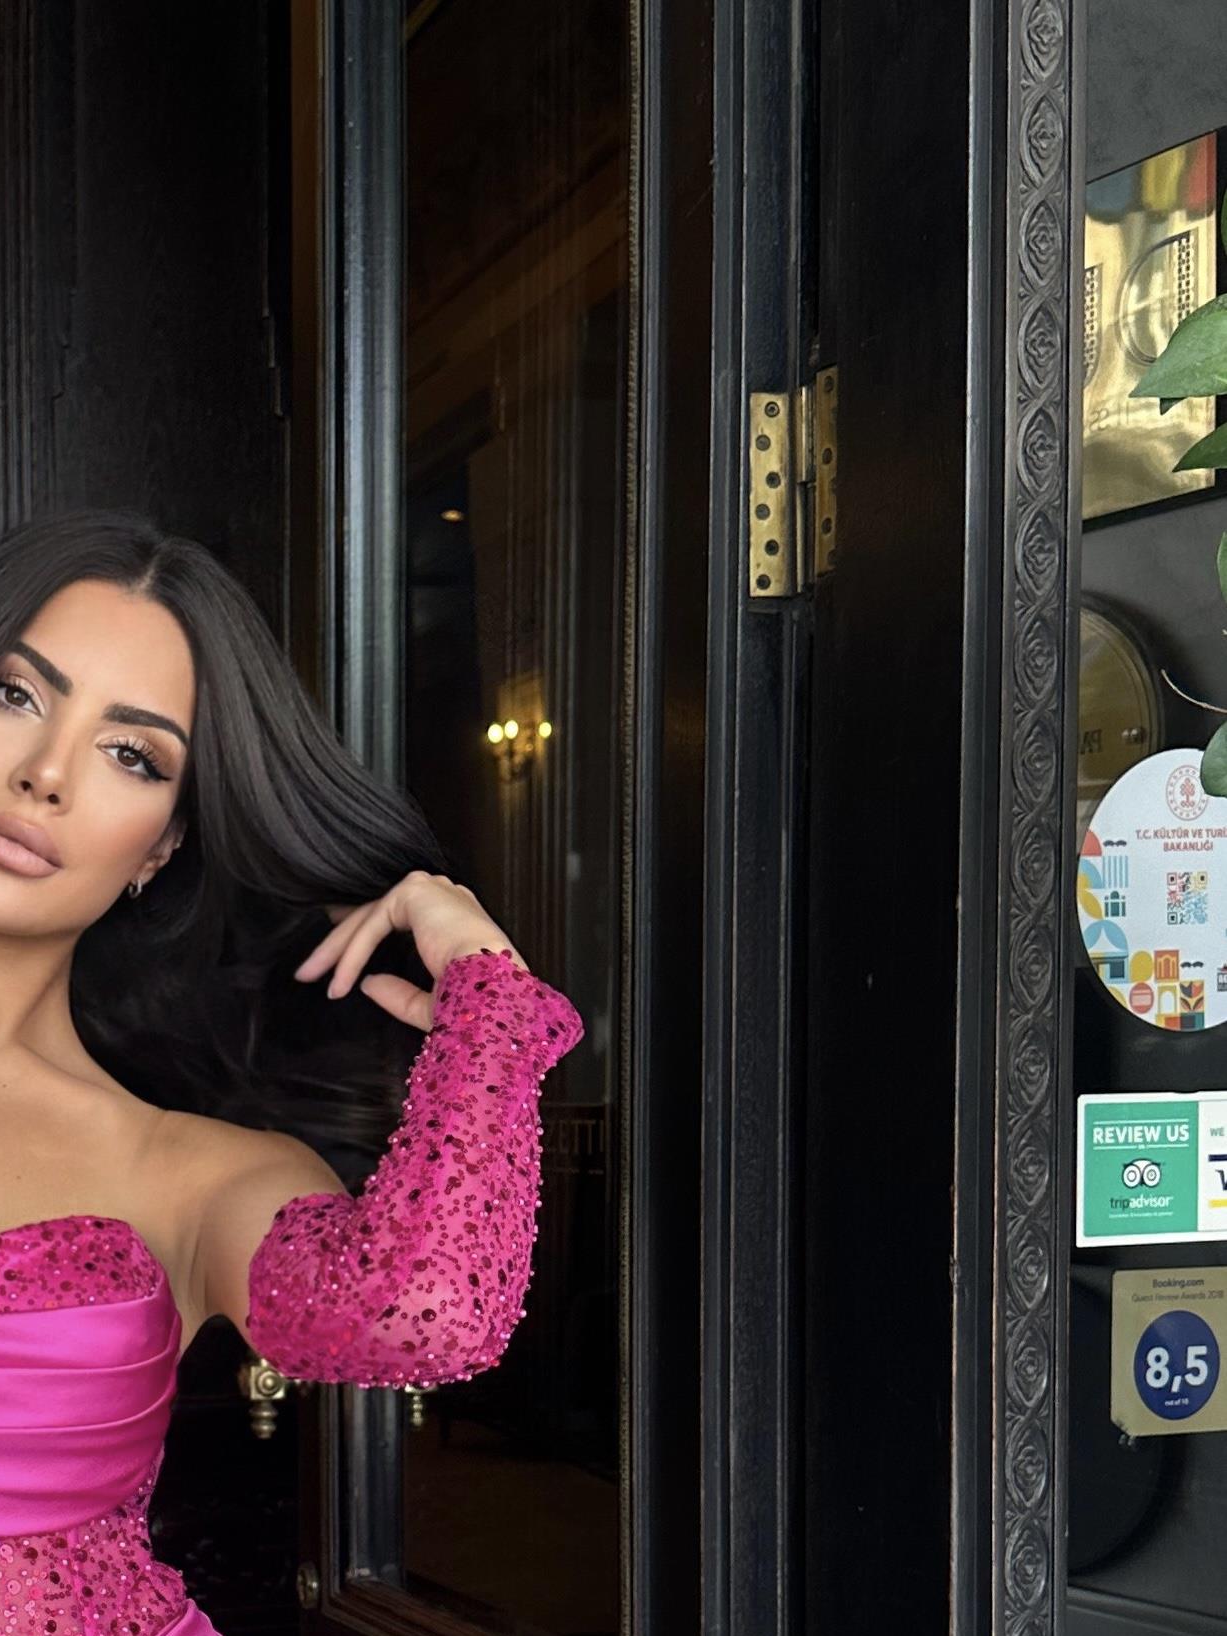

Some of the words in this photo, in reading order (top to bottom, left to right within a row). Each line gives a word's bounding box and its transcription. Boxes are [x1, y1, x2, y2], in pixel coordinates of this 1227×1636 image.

[1153, 827, 1189, 839] KÜLTÜR
[1191, 828, 1203, 838] VE
[1093, 1125, 1161, 1144] REVIEW
[1166, 1124, 1189, 1142] US
[1109, 1194, 1172, 1211] tripadvisor
[1152, 1278, 1205, 1289] Booking.com
[1145, 1345, 1209, 1393] 8,5
